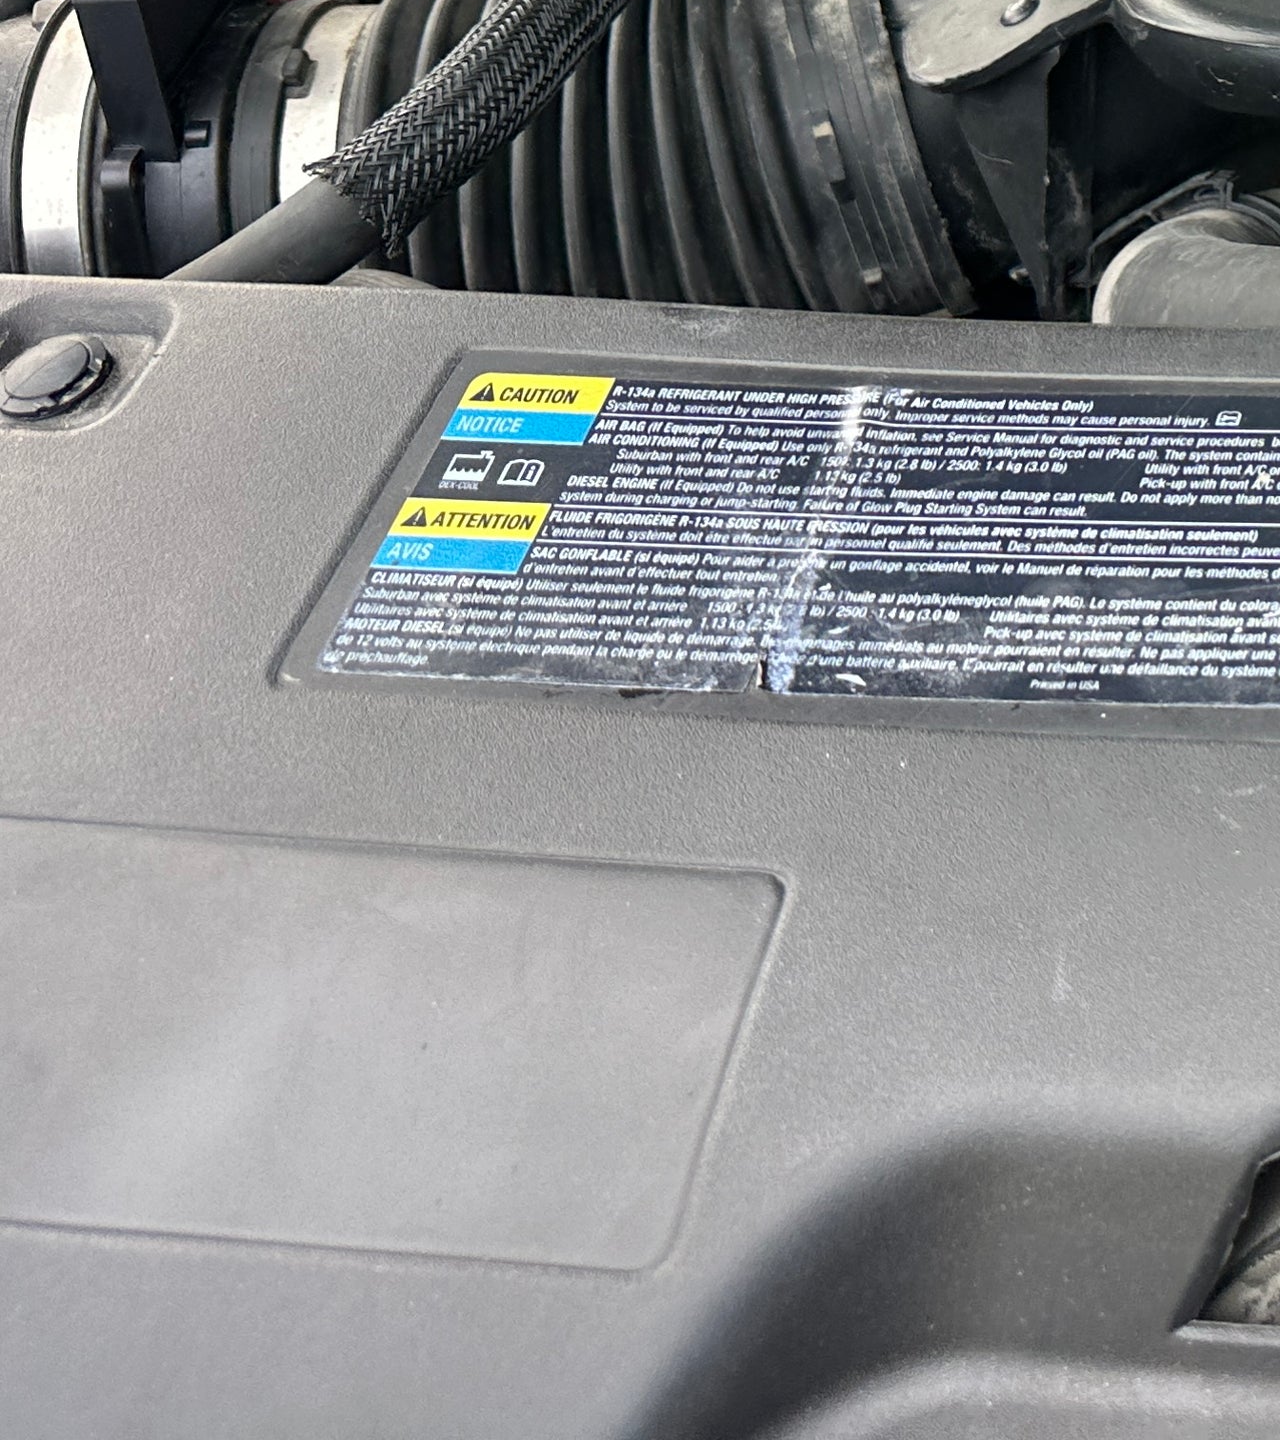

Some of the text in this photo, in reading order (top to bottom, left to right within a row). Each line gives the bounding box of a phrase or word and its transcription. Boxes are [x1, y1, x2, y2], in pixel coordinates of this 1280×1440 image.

[500, 388, 579, 405] CAUTION
[612, 385, 656, 399] R-134a
[657, 388, 741, 401] REFRIGERANT
[742, 392, 785, 403] UNDER
[786, 393, 818, 404] HIGH
[910, 397, 930, 408] Air
[932, 398, 1006, 410] Conditioned
[1008, 399, 1059, 411] Vehicles
[456, 415, 523, 433] NOTICE
[606, 400, 649, 416] System
[651, 402, 664, 412] to
[665, 402, 681, 413] be
[683, 405, 734, 415] serviced
[733, 408, 750, 420] by
[752, 407, 804, 421] qualified
[895, 411, 949, 425] Improper
[951, 413, 995, 423] service
[997, 414, 1050, 424] methods
[1052, 418, 1079, 428] may
[1080, 416, 1117, 425] cause
[1119, 417, 1172, 430] personal
[594, 417, 619, 431] AIR
[619, 420, 646, 432] BAG
[728, 424, 742, 435] To
[744, 425, 770, 438] help
[771, 427, 806, 438] avoid
[921, 433, 944, 442] see
[945, 431, 990, 443] Service
[992, 432, 1039, 444] Manual
[1040, 433, 1057, 444] for
[1060, 434, 1123, 449] diagnostic
[1124, 435, 1149, 446] and
[1150, 437, 1195, 446] service
[1196, 436, 1265, 448] procedures
[430, 511, 536, 531] ATTENTION
[387, 543, 434, 560] AVIS
